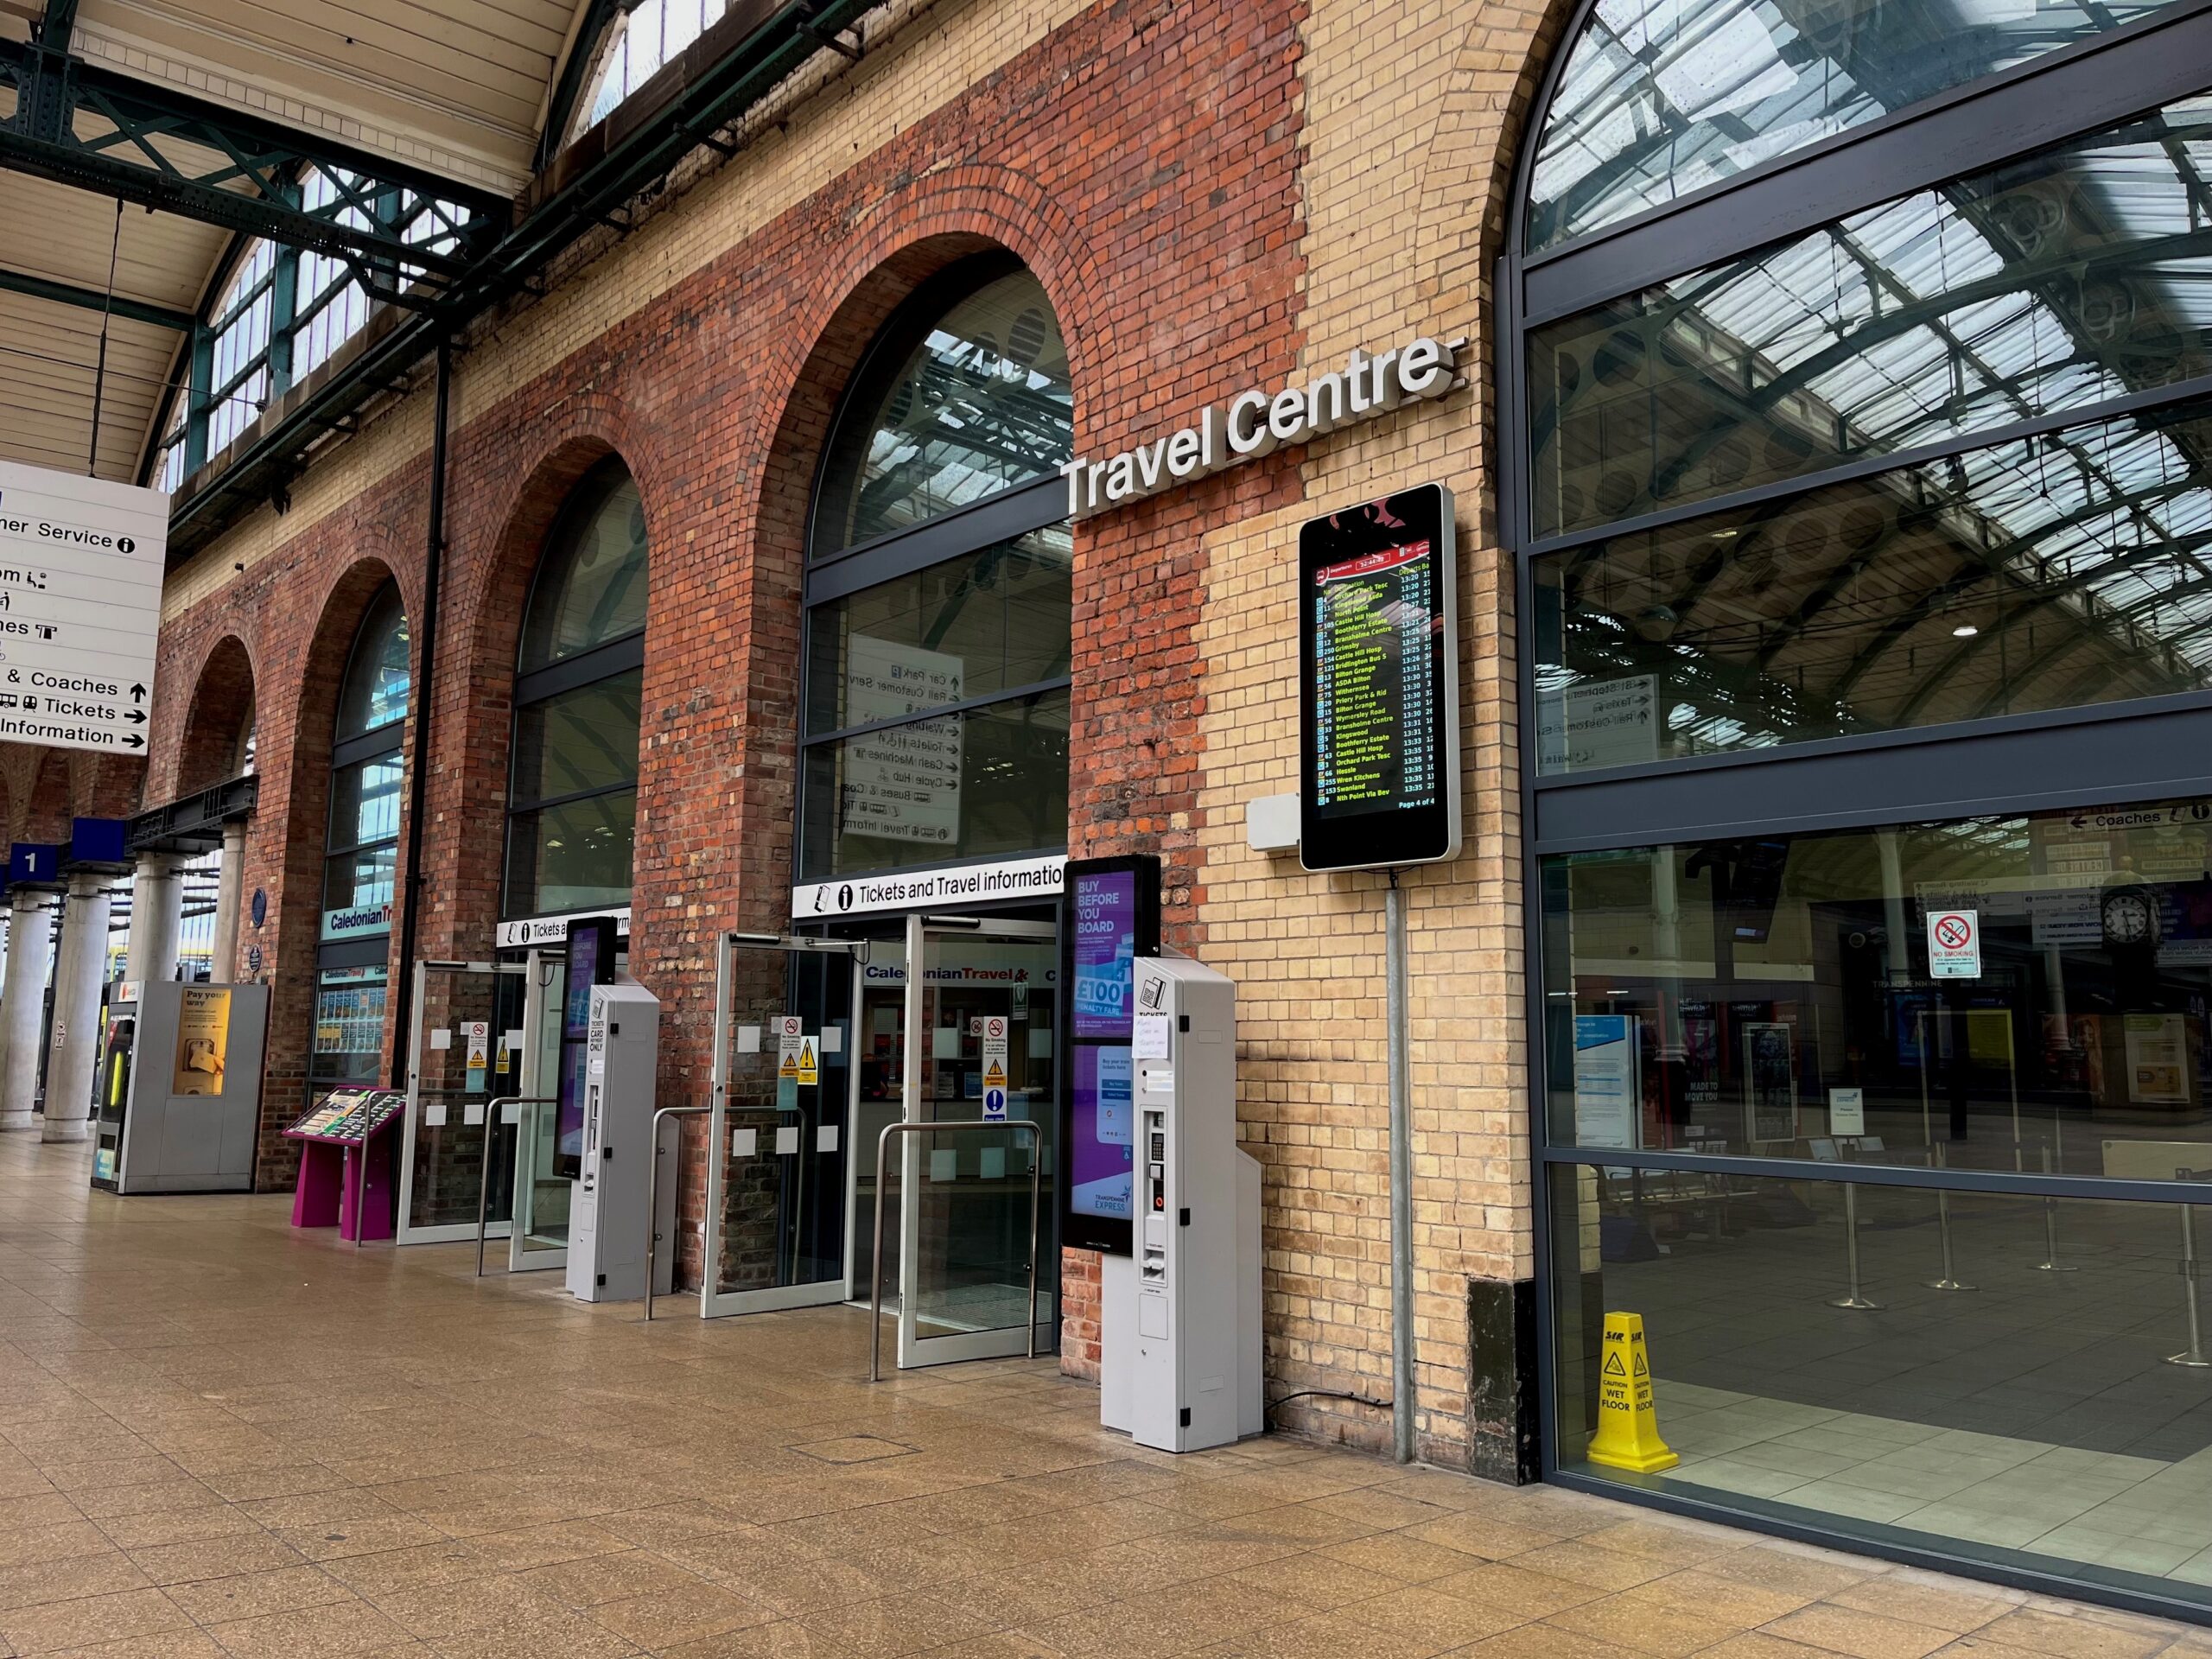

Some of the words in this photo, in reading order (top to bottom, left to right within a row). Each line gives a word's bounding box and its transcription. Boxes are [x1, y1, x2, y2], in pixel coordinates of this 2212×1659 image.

[1059, 404, 1221, 519] Travel
[1228, 336, 1454, 458] Centre
[39, 523, 112, 548] Service
[1402, 574, 1419, 582] 13:20
[1402, 583, 1419, 592] 13:20
[1402, 593, 1419, 601] 13:20
[1371, 626, 1392, 635] Centre
[1335, 643, 1359, 652] Grimsby
[1402, 628, 1420, 637] 13:25
[1402, 637, 1420, 646] 13:25
[1335, 658, 1368, 670] Bridlington
[1402, 646, 1420, 655] 13:25
[1335, 670, 1353, 678] Bilton
[1354, 665, 1376, 675] Grange
[1335, 678, 1351, 687] ASDA
[1353, 675, 1370, 683] Bilton
[1402, 664, 1420, 673] 13:31
[8, 670, 21, 683] &
[31, 672, 118, 696] Coaches
[1335, 685, 1370, 696] Withernsea
[1402, 673, 1421, 683] 13:30
[1336, 696, 1353, 705] Priory
[1355, 692, 1369, 701] Park
[1403, 683, 1421, 691] 13:30
[1355, 701, 1376, 709] Grange
[1403, 692, 1421, 701] 13:30
[45, 698, 116, 720] Tickets
[1336, 711, 1369, 722] Wymersley
[1403, 701, 1421, 709] 13:30
[1372, 715, 1394, 724] Centre
[1403, 710, 1421, 719] 13:30
[1, 719, 113, 744] Information
[1336, 728, 1369, 740] Kingswood
[1337, 737, 1368, 748] Boothferry
[1370, 734, 1389, 743] Estate
[1404, 728, 1421, 737] 13:31
[1337, 749, 1355, 758] Castle
[1404, 738, 1421, 747] 13:33
[1337, 757, 1360, 766] Orchard
[1404, 747, 1421, 755] 13:35
[1337, 766, 1357, 775] Hessle
[1404, 756, 1422, 765] 13:35
[1337, 775, 1352, 784] Wren
[1354, 772, 1380, 781] Kitchens
[1404, 766, 1422, 774] 13:35
[1337, 783, 1365, 793] Swanland
[1405, 774, 1422, 783] 13:35
[1337, 792, 1348, 802] Nth
[1405, 784, 1422, 792] 13:35
[2096, 811, 2161, 826] Coaches
[24, 852, 35, 872] 1
[860, 882, 906, 904] Tickets
[908, 878, 934, 899] and
[938, 873, 981, 894] Travel
[1077, 880, 1099, 894] BUY
[1077, 892, 1120, 907] BEFORE
[1077, 906, 1100, 920] YOU
[533, 924, 560, 938] Tickets
[1077, 919, 1115, 934] BOARD
[187, 990, 203, 999] Pay
[205, 992, 226, 1001] your
[1077, 980, 1121, 1003] £100
[1104, 1006, 1120, 1016] FARE
[590, 1030, 603, 1039] CARD
[589, 1044, 603, 1052] ONLY
[1690, 1082, 1707, 1090] MADE
[1709, 1082, 1718, 1090] TO
[1704, 1091, 1718, 1101] YOU
[1096, 1201, 1125, 1211] EXPRESS
[1603, 1379, 1628, 1389] CAUTION
[1606, 1389, 1624, 1399] WET
[1637, 1389, 1649, 1400] WET
[1602, 1399, 1630, 1412] FLOOR
[1637, 1400, 1653, 1412] FLOOR
